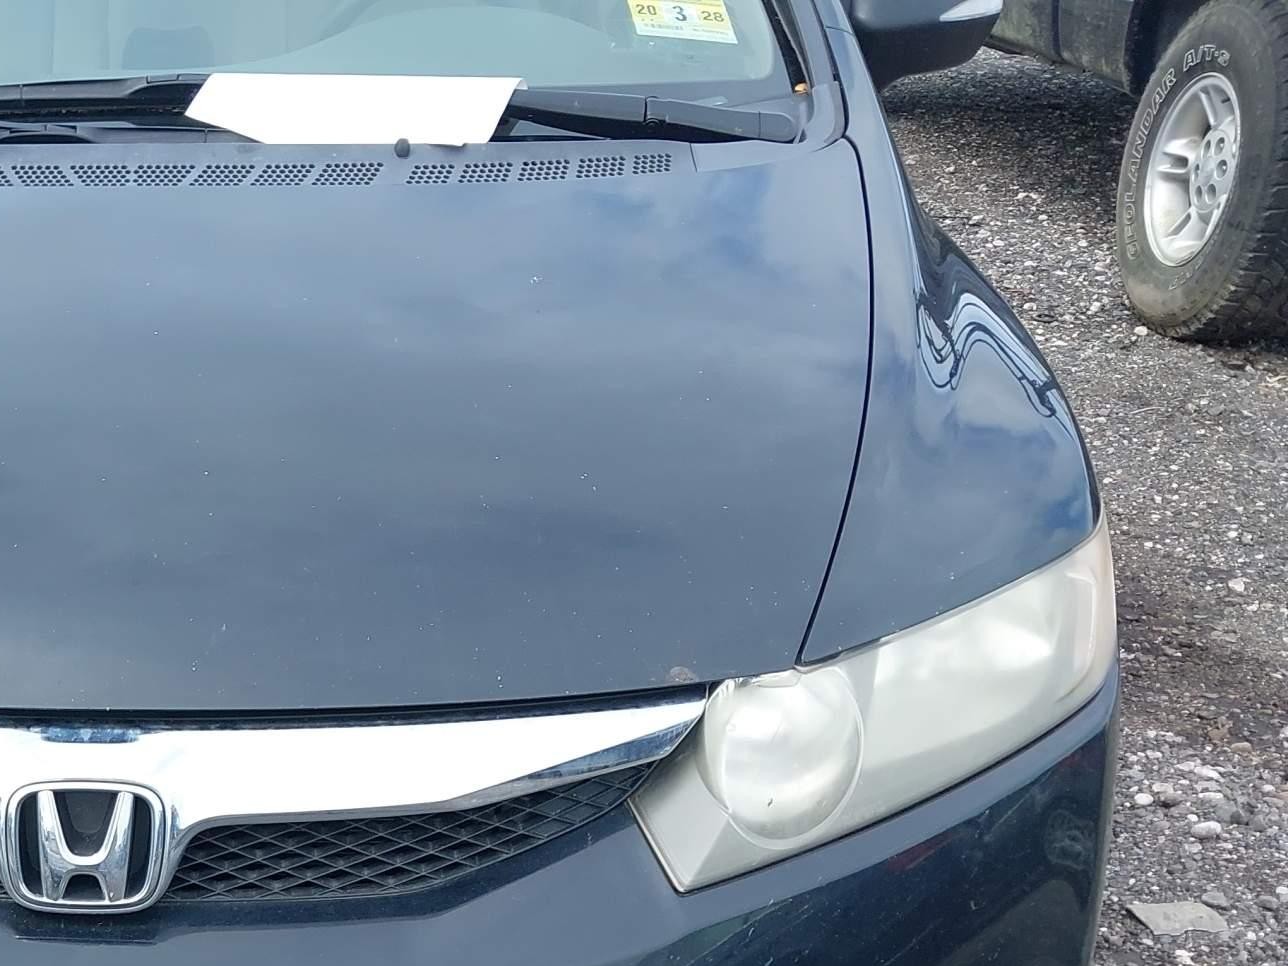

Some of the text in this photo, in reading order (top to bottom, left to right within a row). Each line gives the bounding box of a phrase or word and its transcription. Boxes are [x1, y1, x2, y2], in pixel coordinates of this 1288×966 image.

[635, 3, 725, 23] 20 3 28
